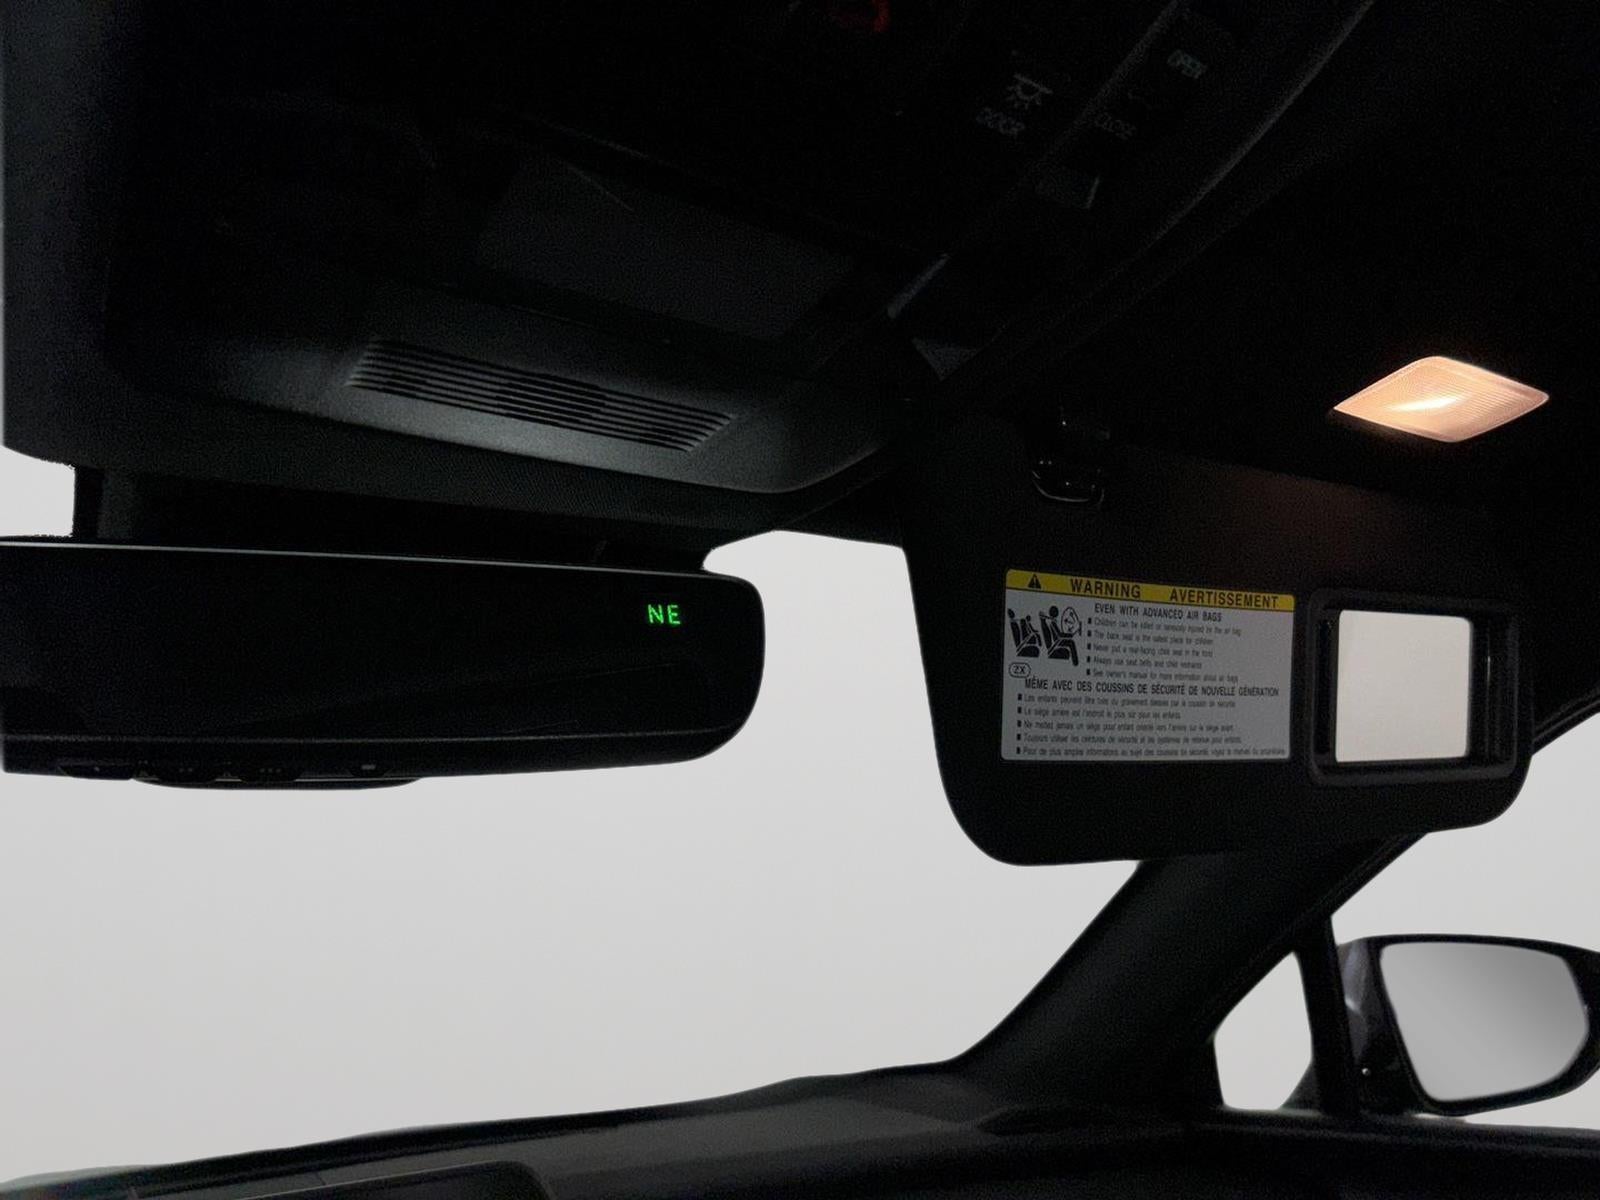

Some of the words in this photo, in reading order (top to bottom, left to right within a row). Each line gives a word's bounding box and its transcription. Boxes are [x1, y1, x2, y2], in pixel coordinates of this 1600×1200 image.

[1070, 578, 1141, 599] WARNING
[1169, 588, 1279, 608] AVERTISSEMENT
[648, 604, 680, 624] NE
[1094, 602, 1115, 614] EVEN
[1119, 605, 1139, 616] WITH
[1142, 607, 1184, 619] ADVANCED
[1186, 609, 1199, 620] AIR
[1202, 611, 1222, 622] BAGS
[1052, 680, 1073, 691] AVEC
[1077, 681, 1092, 692] DES
[1096, 682, 1134, 693] COUSSINS
[1137, 683, 1148, 694] DE
[1202, 686, 1236, 696] NOUVELLE
